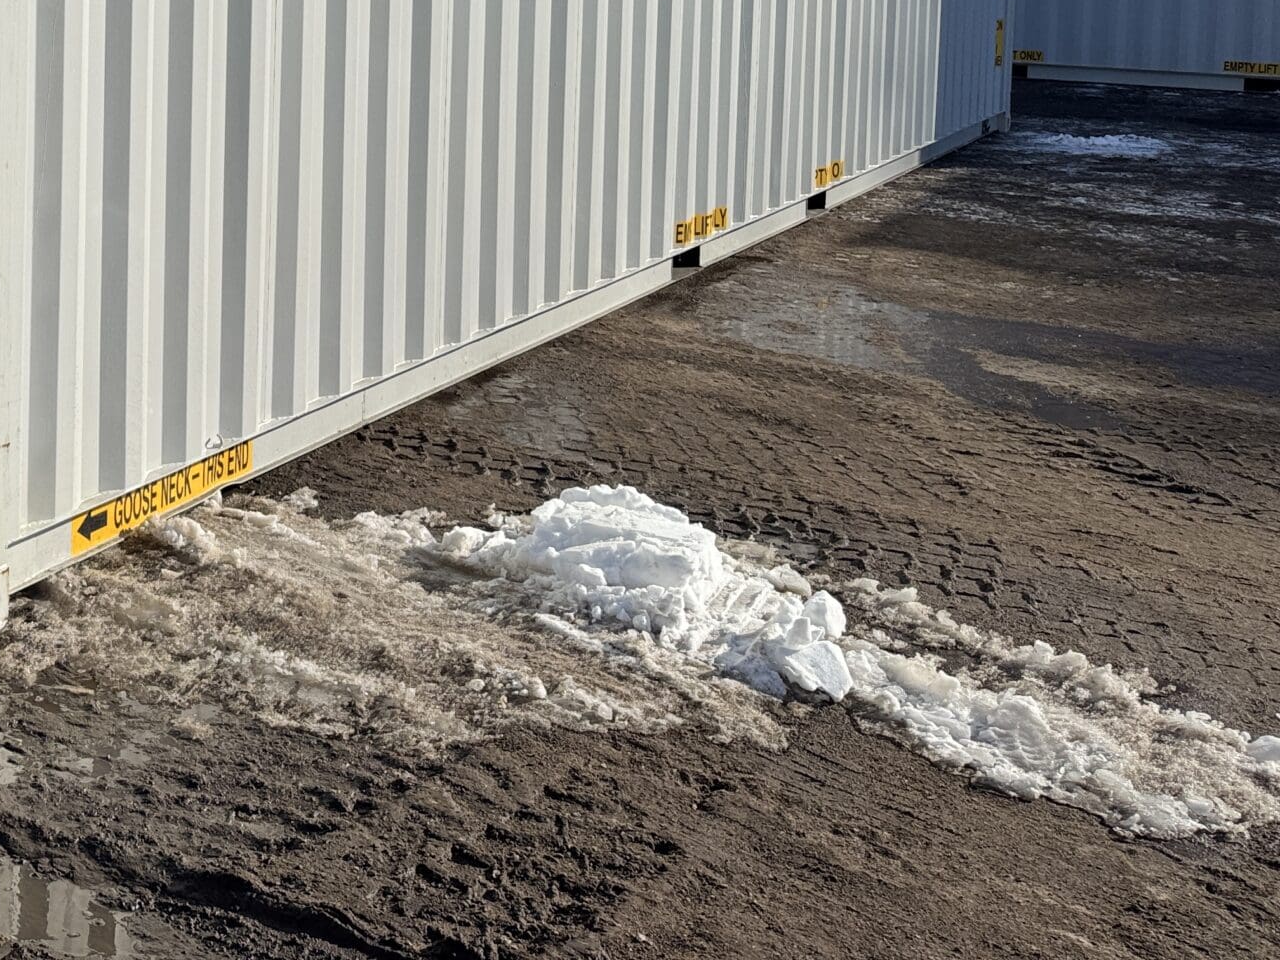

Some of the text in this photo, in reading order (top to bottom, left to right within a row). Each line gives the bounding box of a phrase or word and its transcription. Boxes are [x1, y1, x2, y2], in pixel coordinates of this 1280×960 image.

[1020, 50, 1042, 61] ONLY
[1224, 61, 1278, 74] EMPTY LIFT
[114, 482, 157, 529] GOOSE
[227, 440, 249, 476] END
